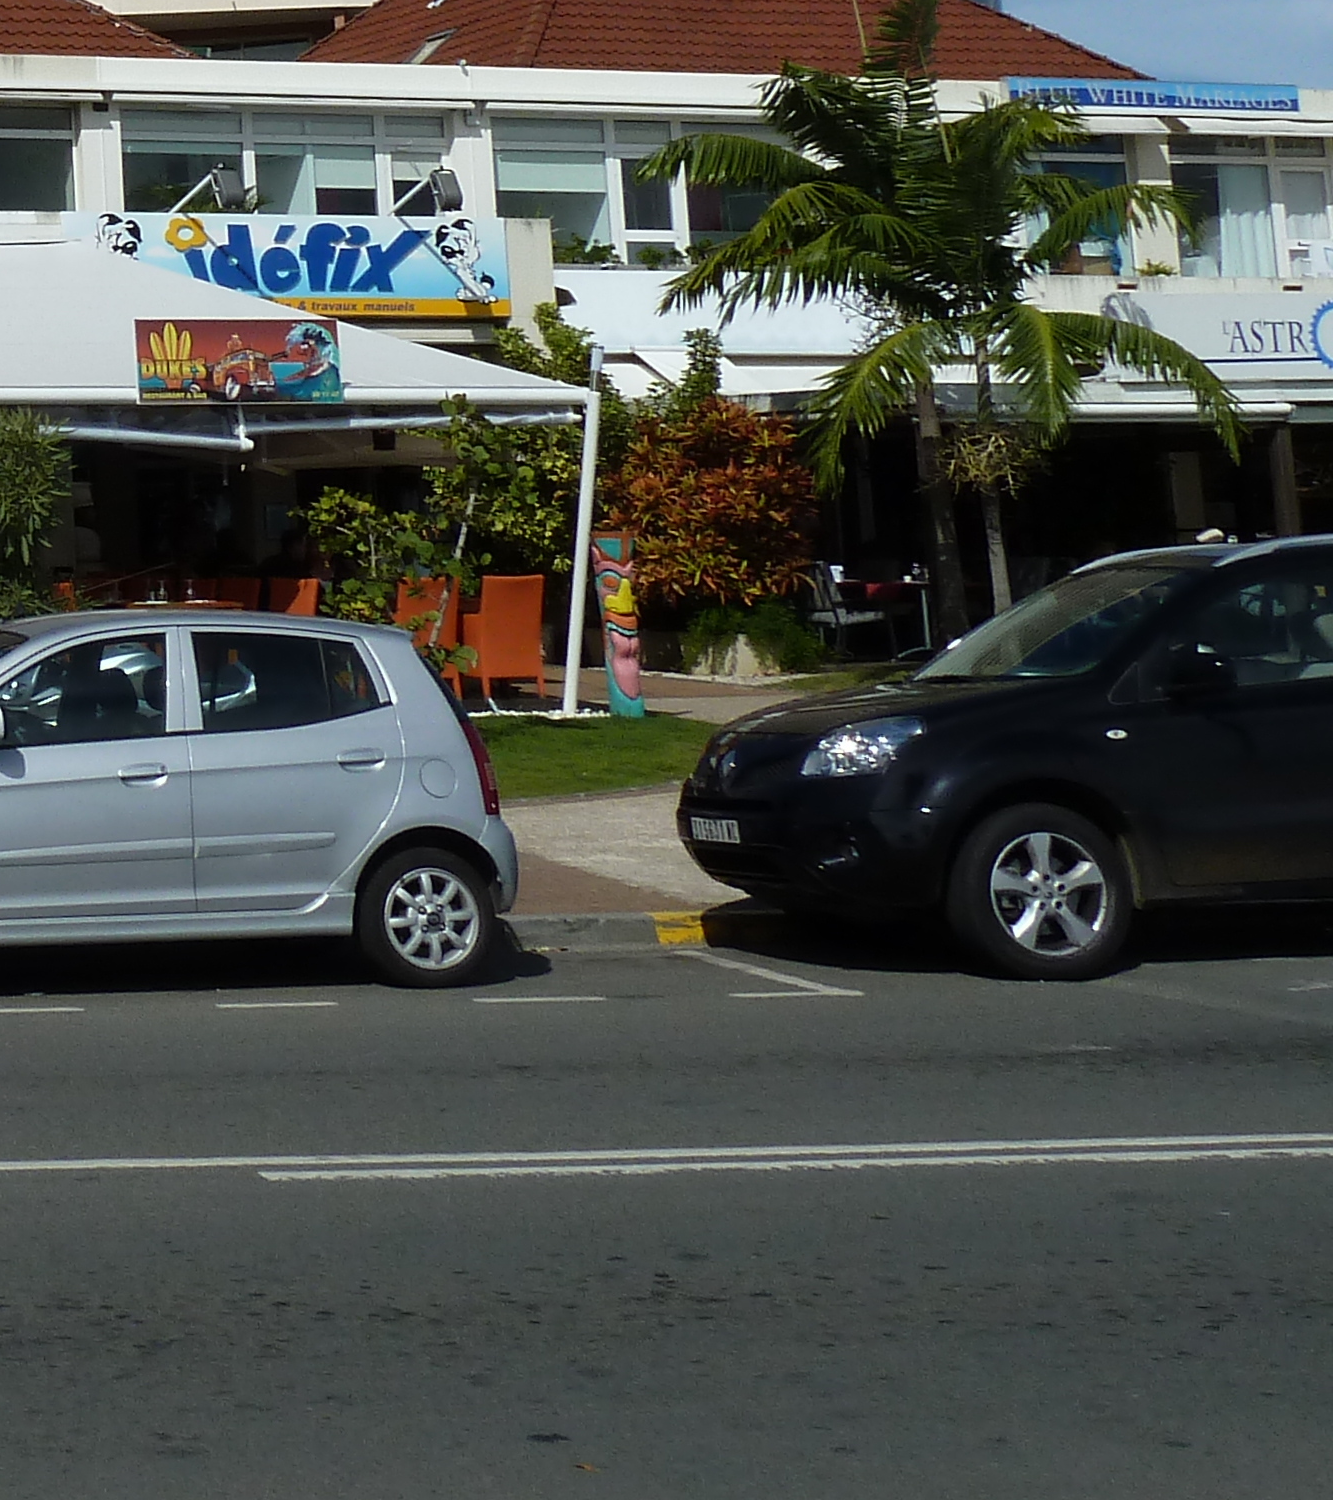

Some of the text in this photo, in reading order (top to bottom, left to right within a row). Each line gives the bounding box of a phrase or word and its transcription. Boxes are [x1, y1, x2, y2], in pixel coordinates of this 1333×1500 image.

[1086, 83, 1168, 106] WHITE
[1174, 84, 1292, 109] MARIAGES
[165, 218, 432, 293] idéfix
[311, 301, 357, 311] travaux
[363, 301, 415, 312] manuels
